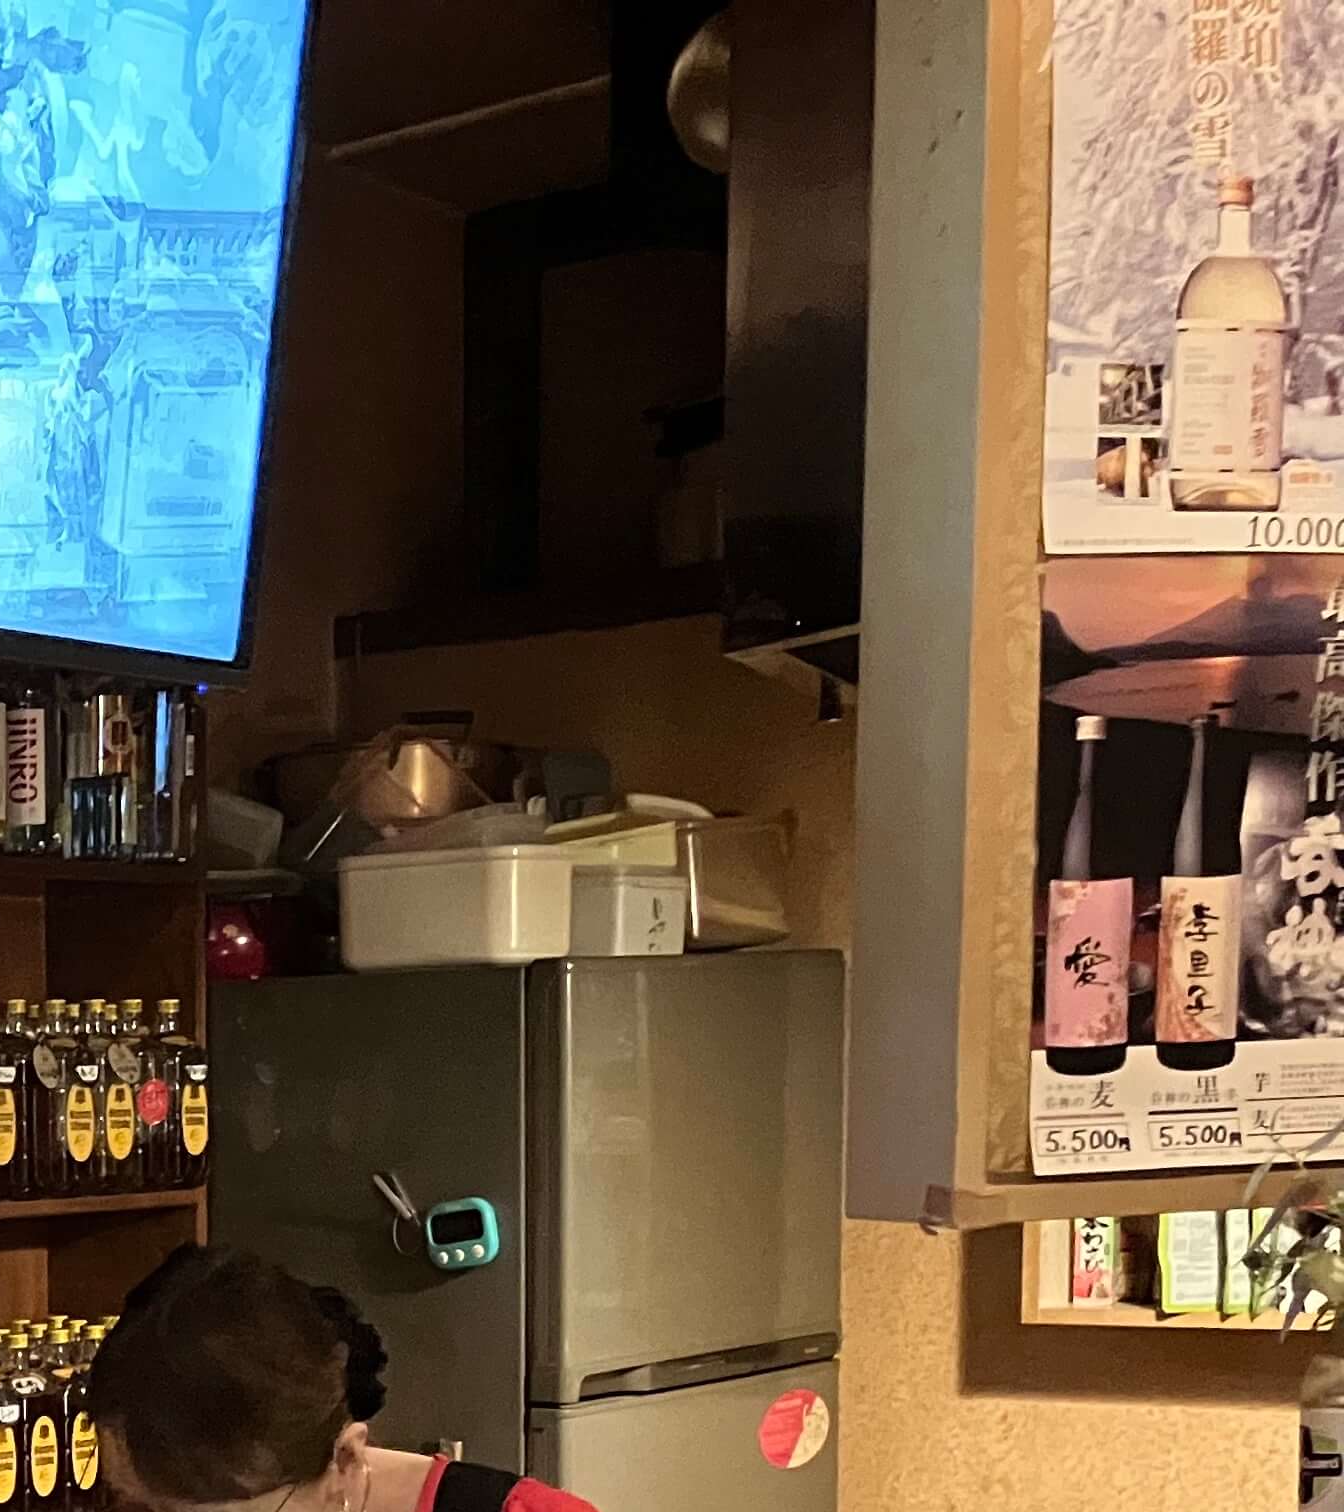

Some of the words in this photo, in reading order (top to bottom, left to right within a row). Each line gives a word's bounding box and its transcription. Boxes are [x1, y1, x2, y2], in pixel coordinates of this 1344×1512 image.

[1190, 0, 1232, 166] 羅の雪
[1064, 937, 1110, 988] 愛
